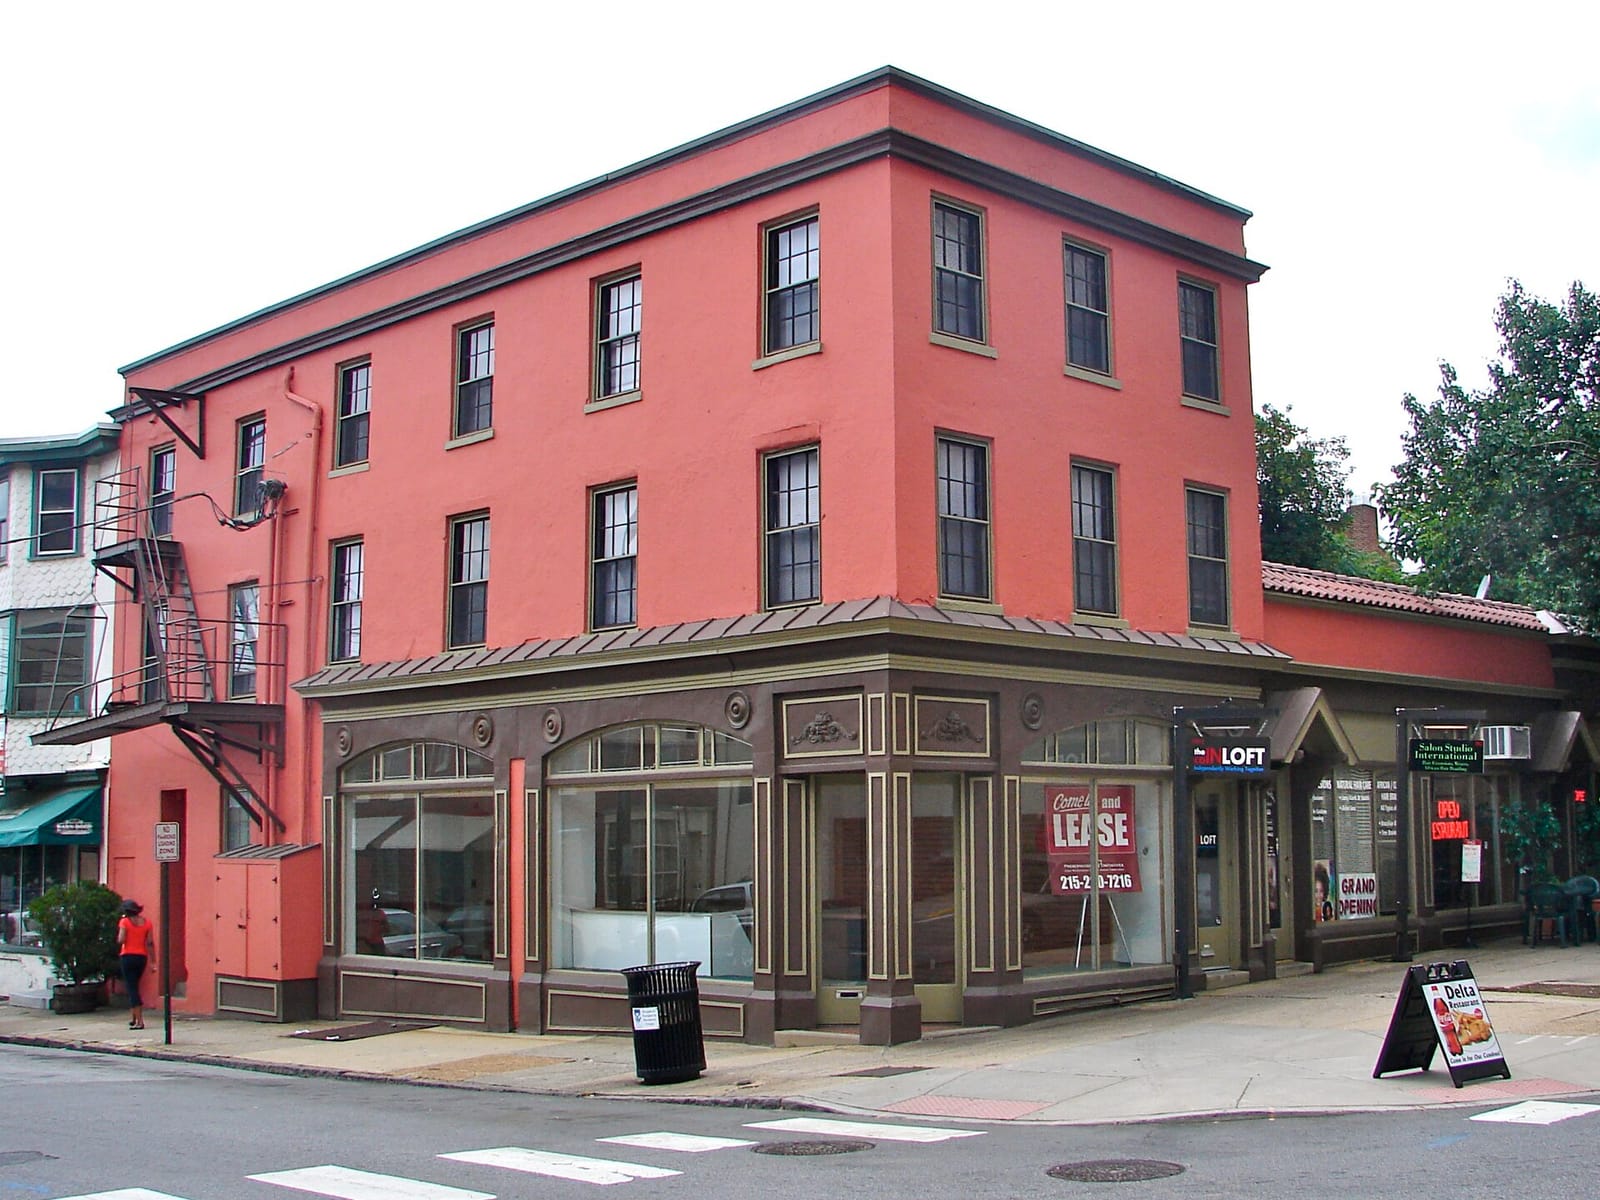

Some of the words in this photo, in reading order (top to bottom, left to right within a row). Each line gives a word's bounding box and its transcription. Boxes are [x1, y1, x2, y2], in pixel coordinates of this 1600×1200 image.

[1419, 742, 1443, 752] Salon
[1444, 743, 1473, 753] Studio
[1415, 750, 1477, 761] International
[1225, 765, 1244, 773] Working
[1245, 765, 1264, 773] Together
[1053, 793, 1084, 811] Come
[1101, 796, 1121, 809] and
[1437, 800, 1460, 819] OPEN
[1053, 812, 1129, 848] LEASE
[1200, 834, 1217, 845] LOFT
[1060, 874, 1132, 890] 215-20-7216
[1341, 877, 1375, 895] GRAND
[1339, 898, 1377, 916] OPENING
[1444, 984, 1476, 999] Delta
[1448, 999, 1480, 1008] Restaurant
